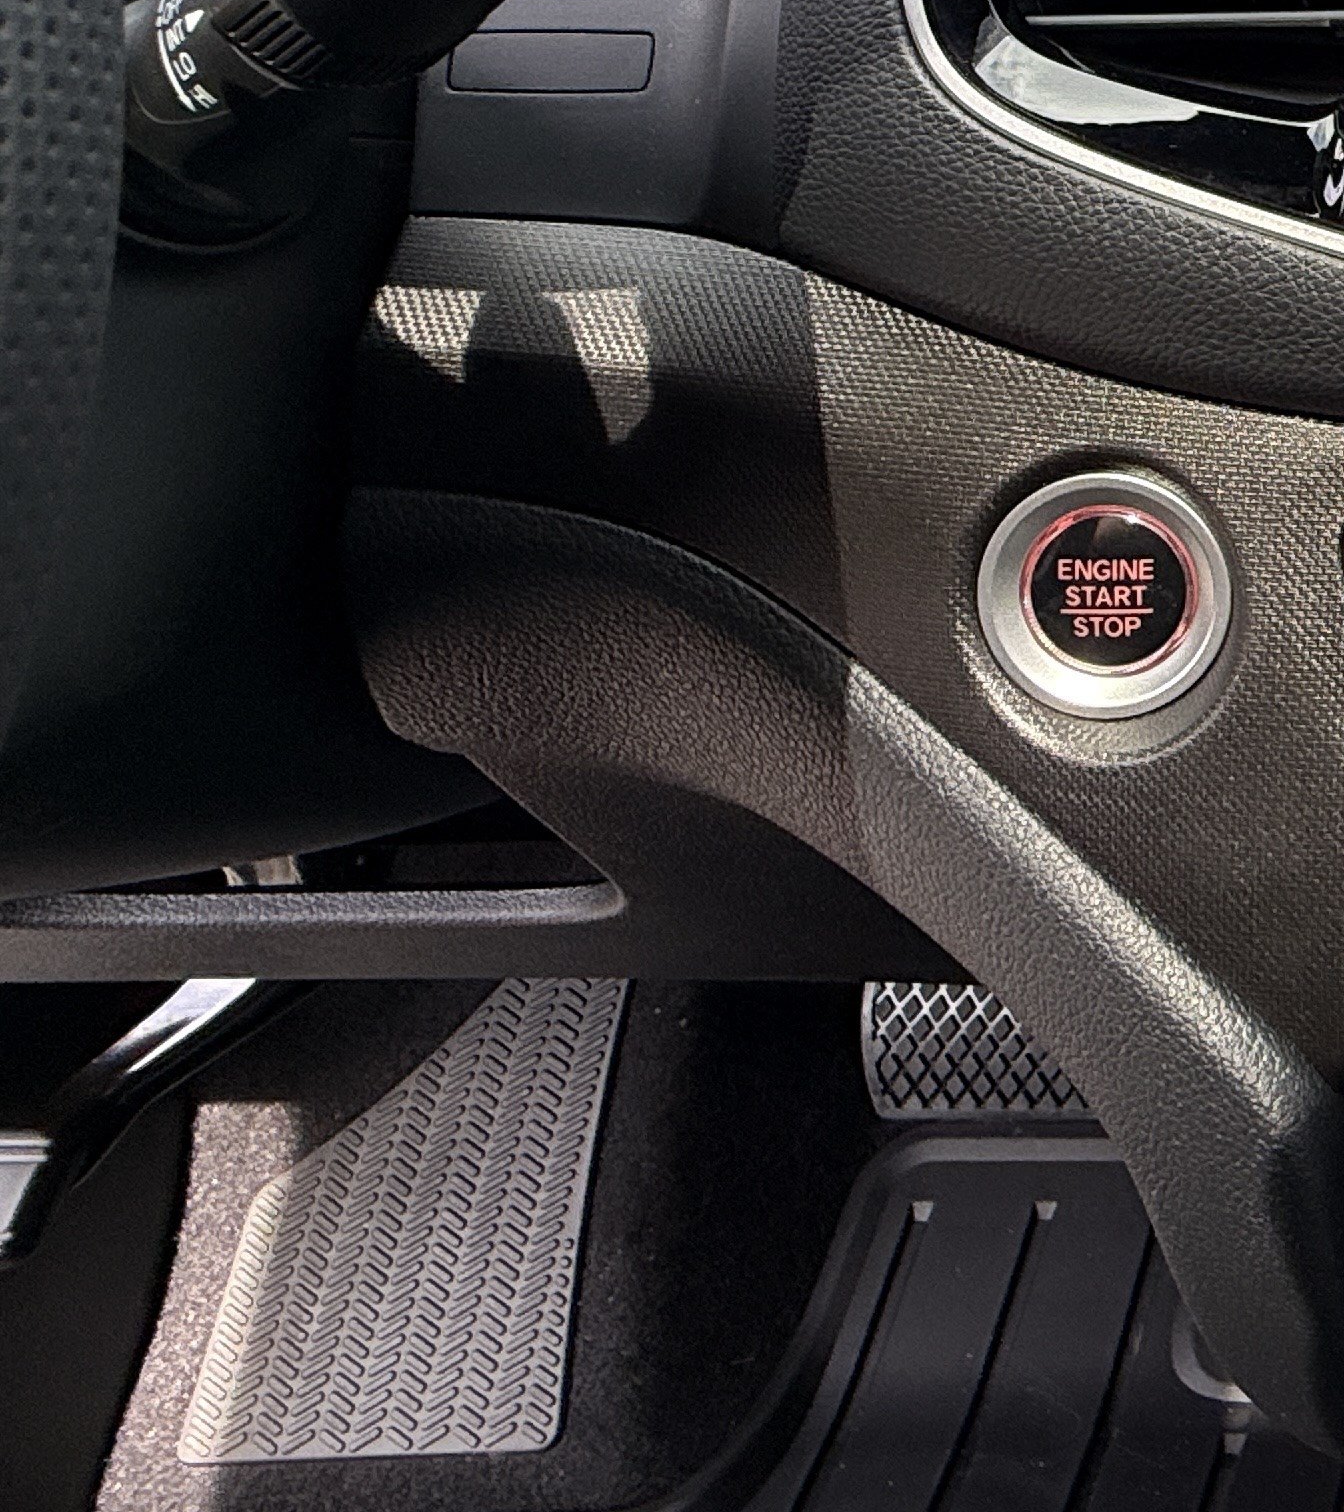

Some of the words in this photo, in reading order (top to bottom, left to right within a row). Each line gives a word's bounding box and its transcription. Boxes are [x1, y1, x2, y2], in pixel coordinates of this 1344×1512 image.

[165, 18, 187, 51] INT
[172, 51, 197, 81] LO
[1057, 558, 1155, 582] ENGINE
[1065, 584, 1148, 607] START
[1073, 616, 1142, 638] STOP
